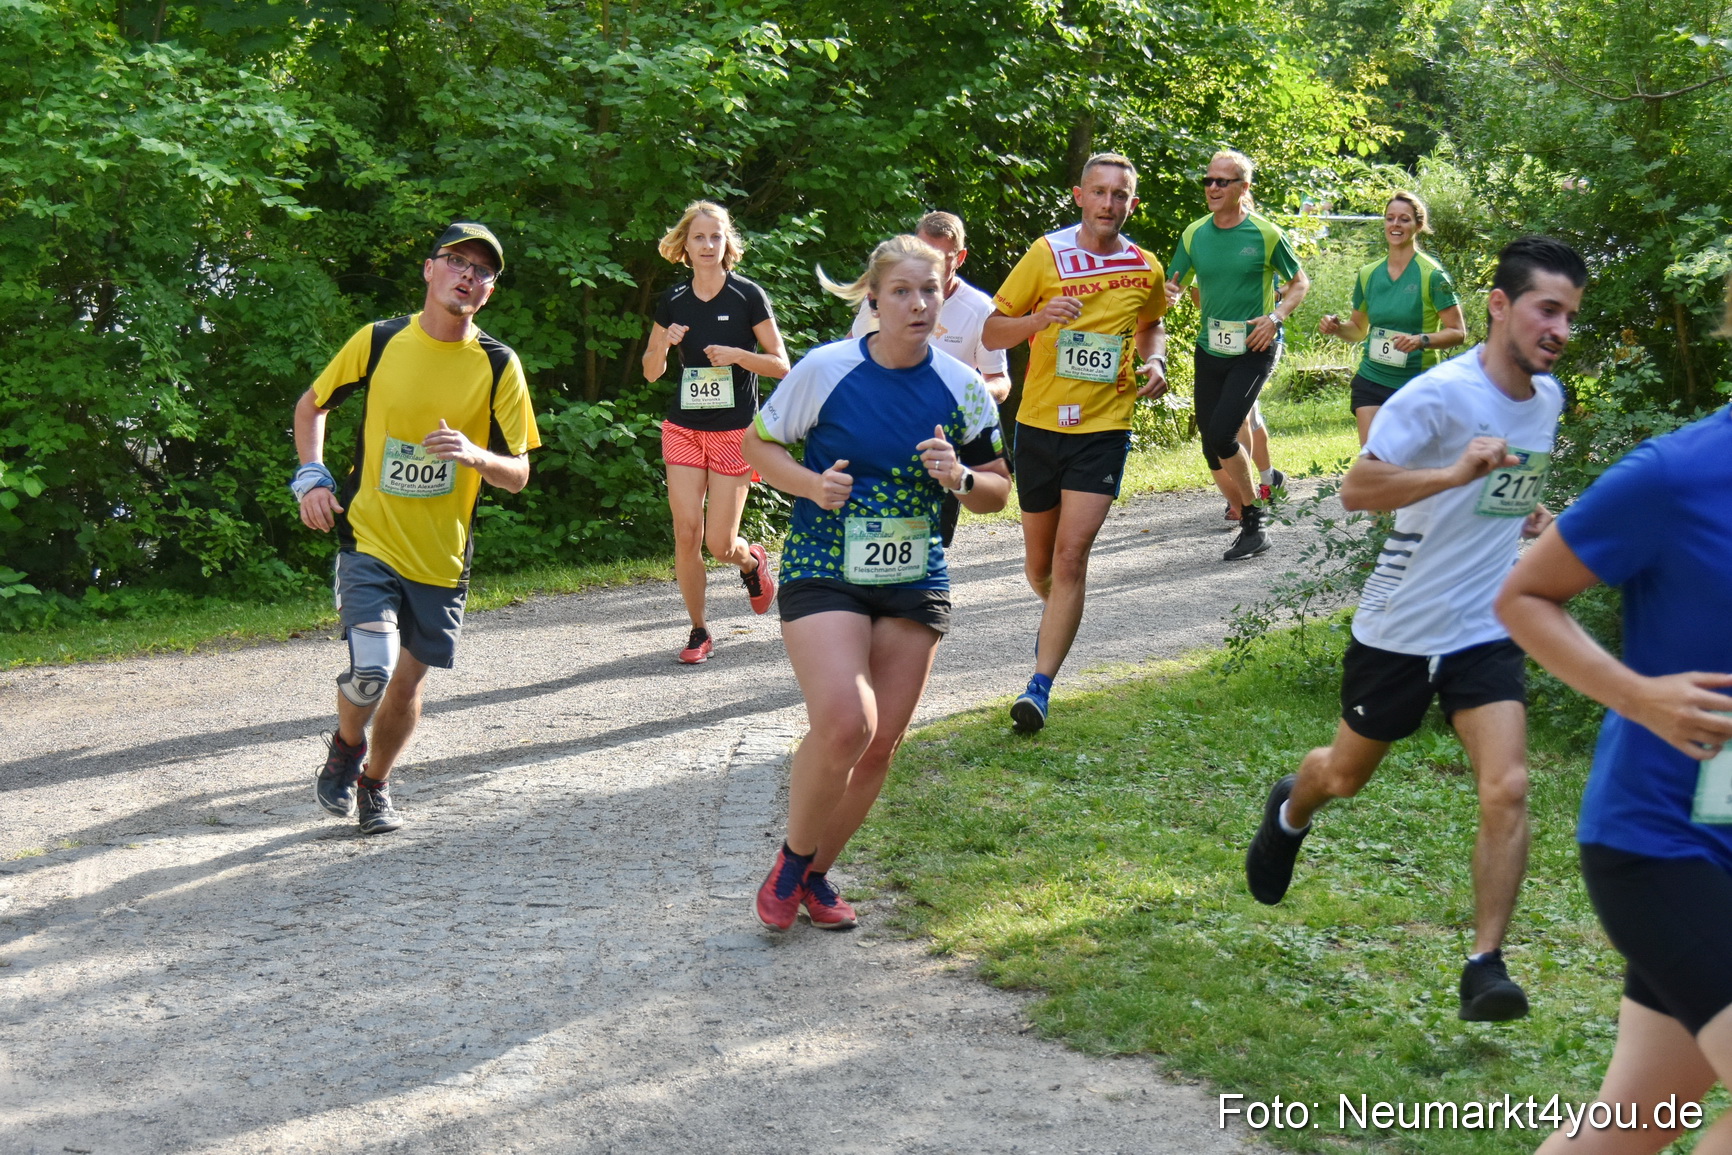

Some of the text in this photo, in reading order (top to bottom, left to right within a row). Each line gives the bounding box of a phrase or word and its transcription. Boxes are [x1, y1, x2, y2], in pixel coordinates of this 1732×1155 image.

[1061, 275, 1153, 297] MAX BÖGL
[1217, 332, 1231, 345] 15
[1382, 342, 1390, 354] 6
[1065, 347, 1112, 369] 1663
[690, 382, 720, 397] 948
[390, 460, 447, 483] 2004
[391, 480, 416, 489] Bergrath
[864, 541, 912, 565] 208
[897, 564, 920, 572] Corinna
